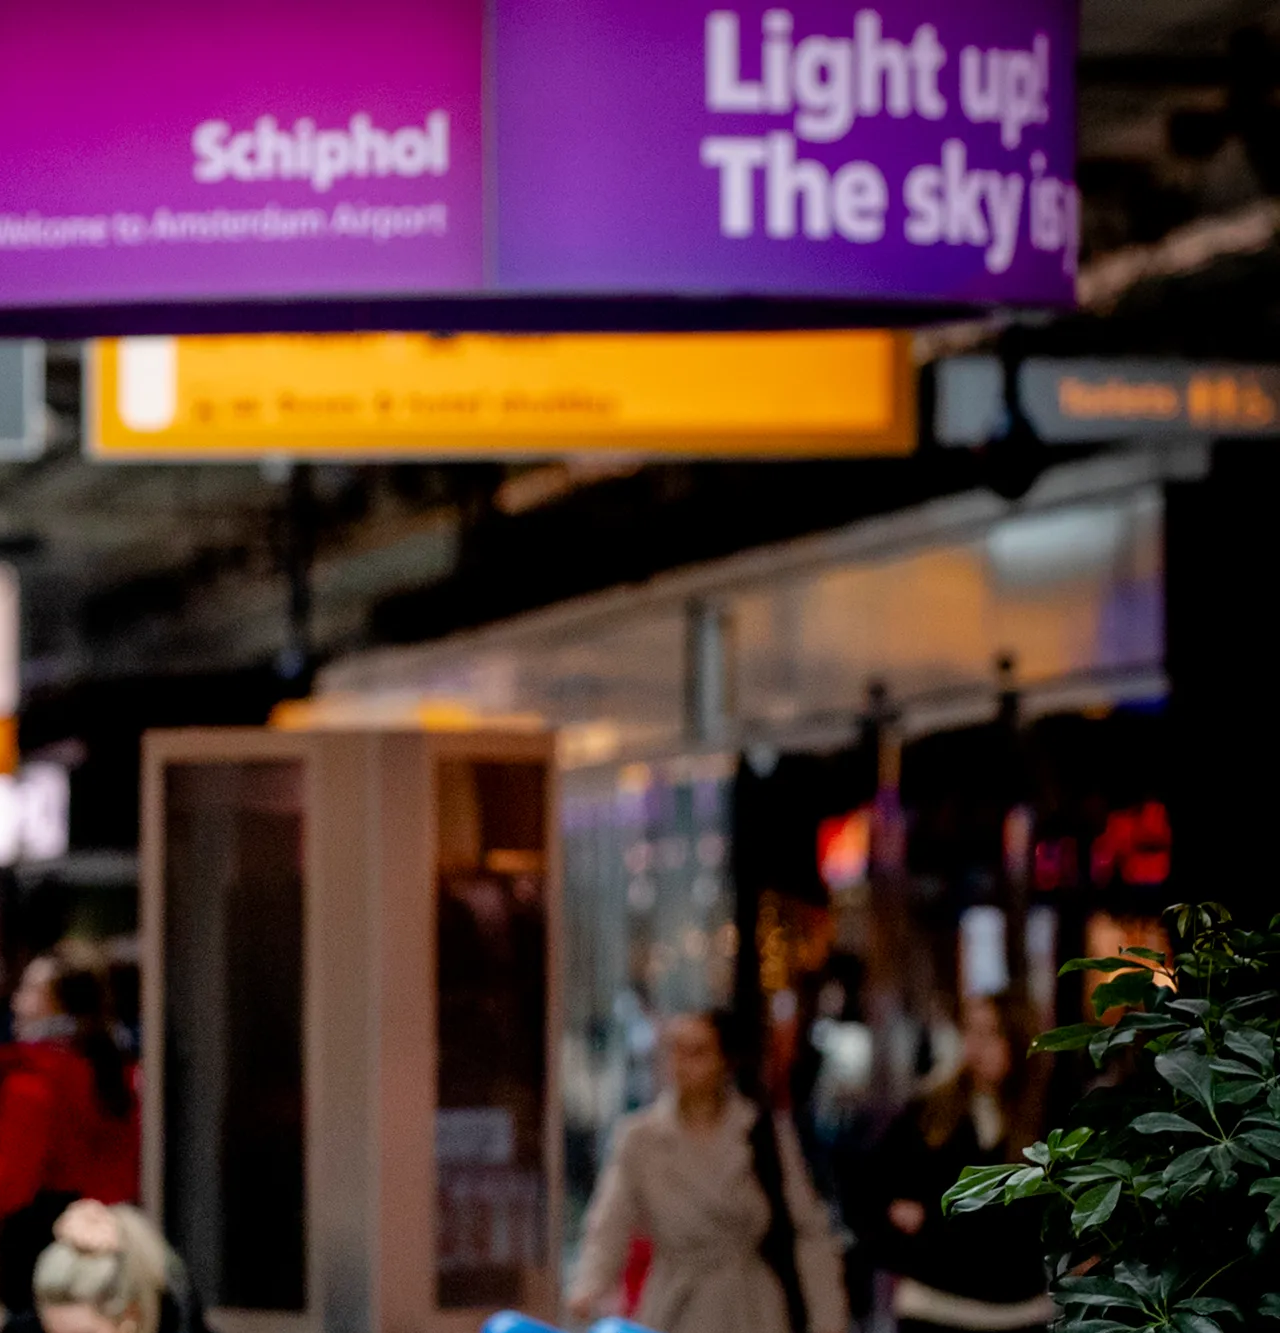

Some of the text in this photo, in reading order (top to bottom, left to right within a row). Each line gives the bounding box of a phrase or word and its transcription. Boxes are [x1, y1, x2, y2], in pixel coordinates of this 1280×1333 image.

[705, 8, 1050, 149] Light up!
[193, 110, 449, 192] Schiphol
[701, 130, 888, 243] The
[903, 139, 1024, 273] sky
[113, 209, 146, 245] to
[149, 204, 328, 240] Amsterdam
[330, 200, 446, 243] Airport
